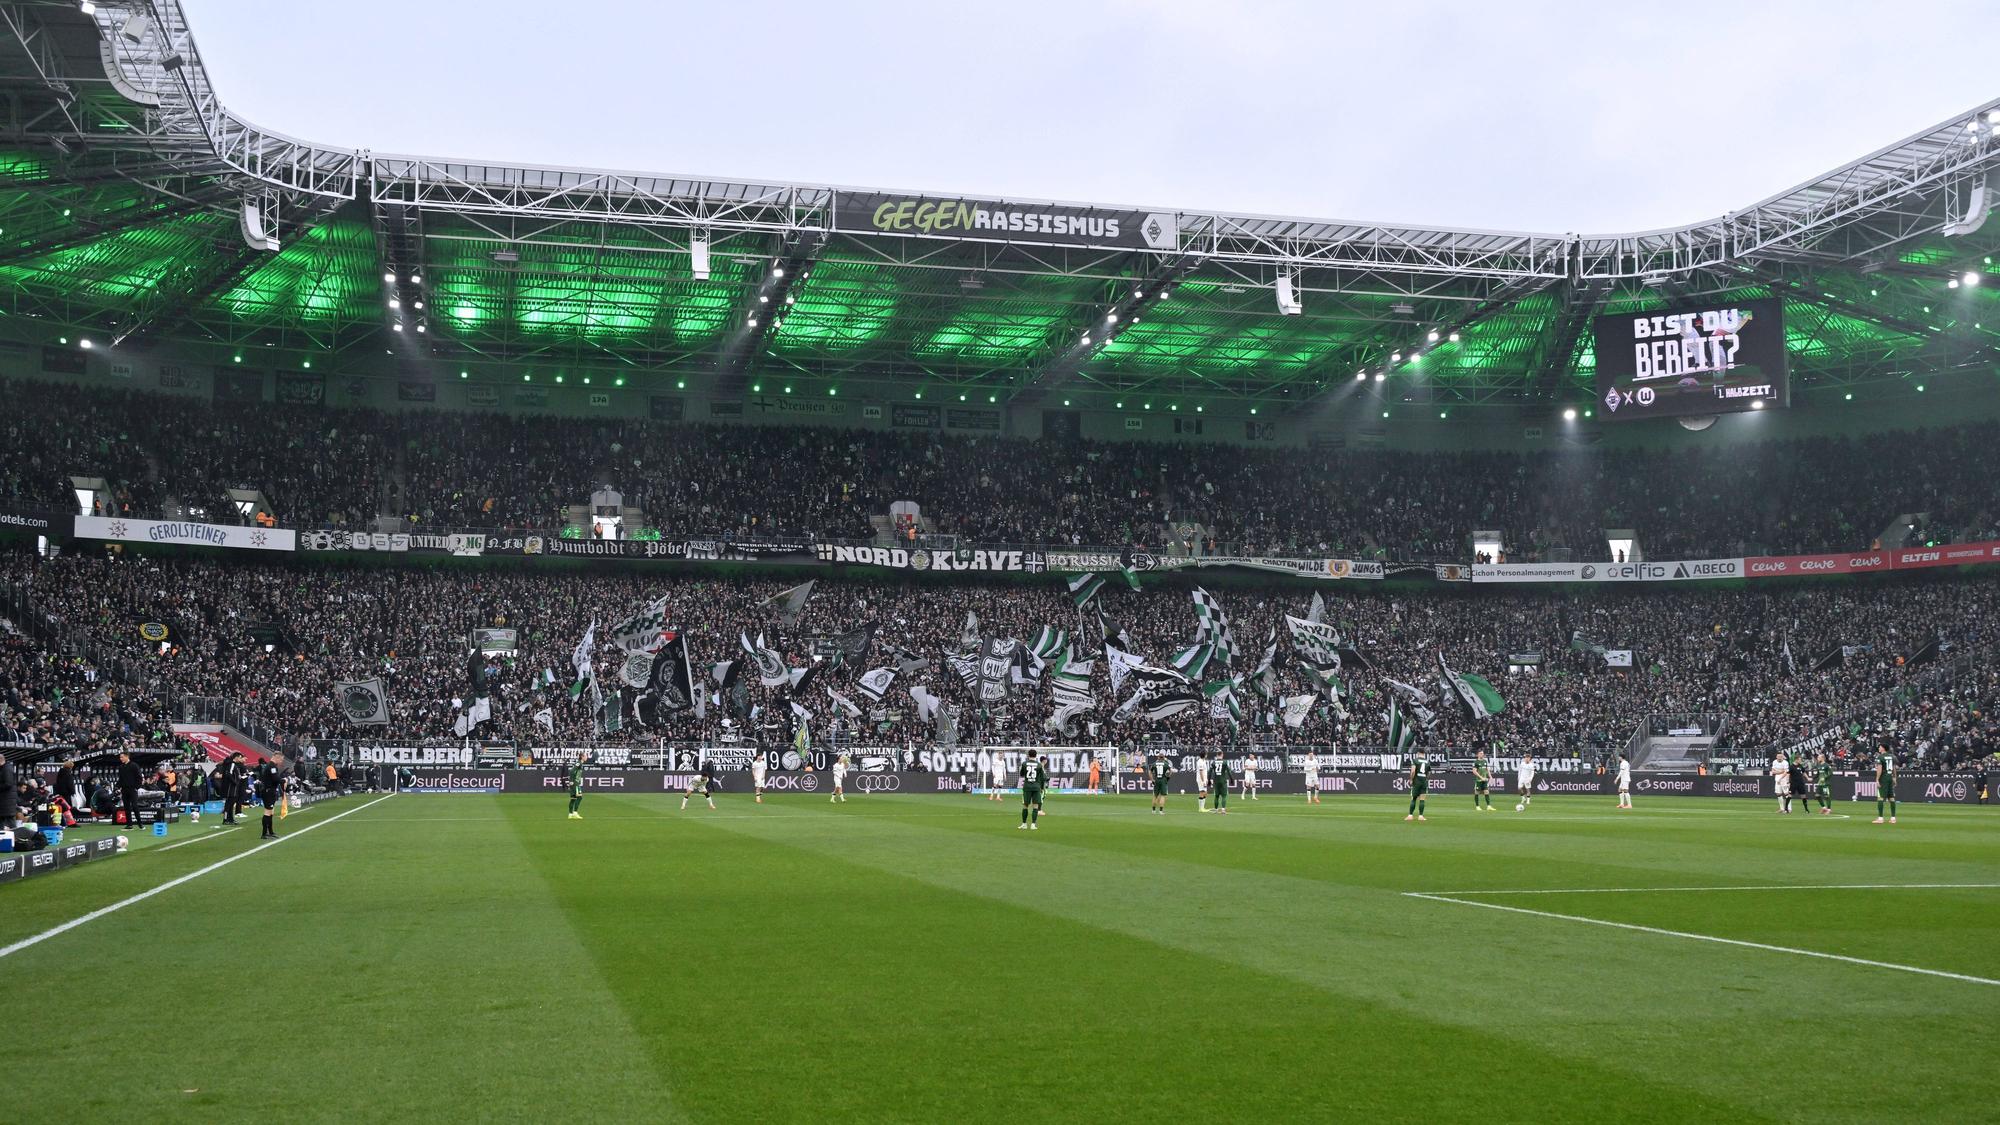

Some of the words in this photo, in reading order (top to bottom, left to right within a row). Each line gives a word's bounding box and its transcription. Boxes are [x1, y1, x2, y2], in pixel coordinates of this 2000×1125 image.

[872, 201, 977, 232] GEGEN
[975, 209, 1119, 237] RASSISMUS
[1634, 313, 1696, 338] BIST
[1702, 308, 1738, 331] DU
[1635, 334, 1740, 377] BEREIT?
[0, 514, 48, 528] otels.com
[149, 524, 227, 546] GEROLSTEINER
[408, 535, 449, 549] UNITED
[549, 538, 626, 555] Humboldt
[644, 540, 688, 558] Pöbel
[835, 546, 909, 569] NORD
[931, 551, 1023, 571] KURVE
[1050, 555, 1121, 567] BORUSSIA
[1800, 558, 1836, 570] cewe
[1850, 556, 1882, 567] cewe
[1902, 551, 1940, 563] ELTEN
[1298, 561, 1325, 572] WILDE
[1352, 562, 1382, 574] JUNGS
[1620, 563, 1665, 579] elfio
[1693, 562, 1736, 575] ABECO
[1751, 560, 1787, 572] cewe
[1497, 569, 1575, 579] Personalmanagement
[359, 747, 473, 764] BOKELBERG
[708, 749, 755, 757] BORUSSIA
[849, 747, 897, 755] FRONTLINE
[1403, 753, 1447, 763] PUCKL
[919, 750, 1091, 773] SOTTOUURA
[1419, 762, 1426, 774] 4
[1885, 759, 1893, 772] 14
[1026, 766, 1037, 779] 25
[416, 773, 505, 789] sure[secure]
[543, 777, 625, 787] RETER
[764, 775, 800, 789] AOK
[937, 777, 980, 792] Bitbuger
[1550, 780, 1601, 791] Santander
[1653, 779, 1694, 793] sonepar
[1713, 780, 1760, 793] sure[secure]
[1854, 781, 1878, 797] PUM
[1925, 782, 1952, 798] AOK
[66, 844, 87, 859] REUTER
[32, 852, 54, 867] REUTER
